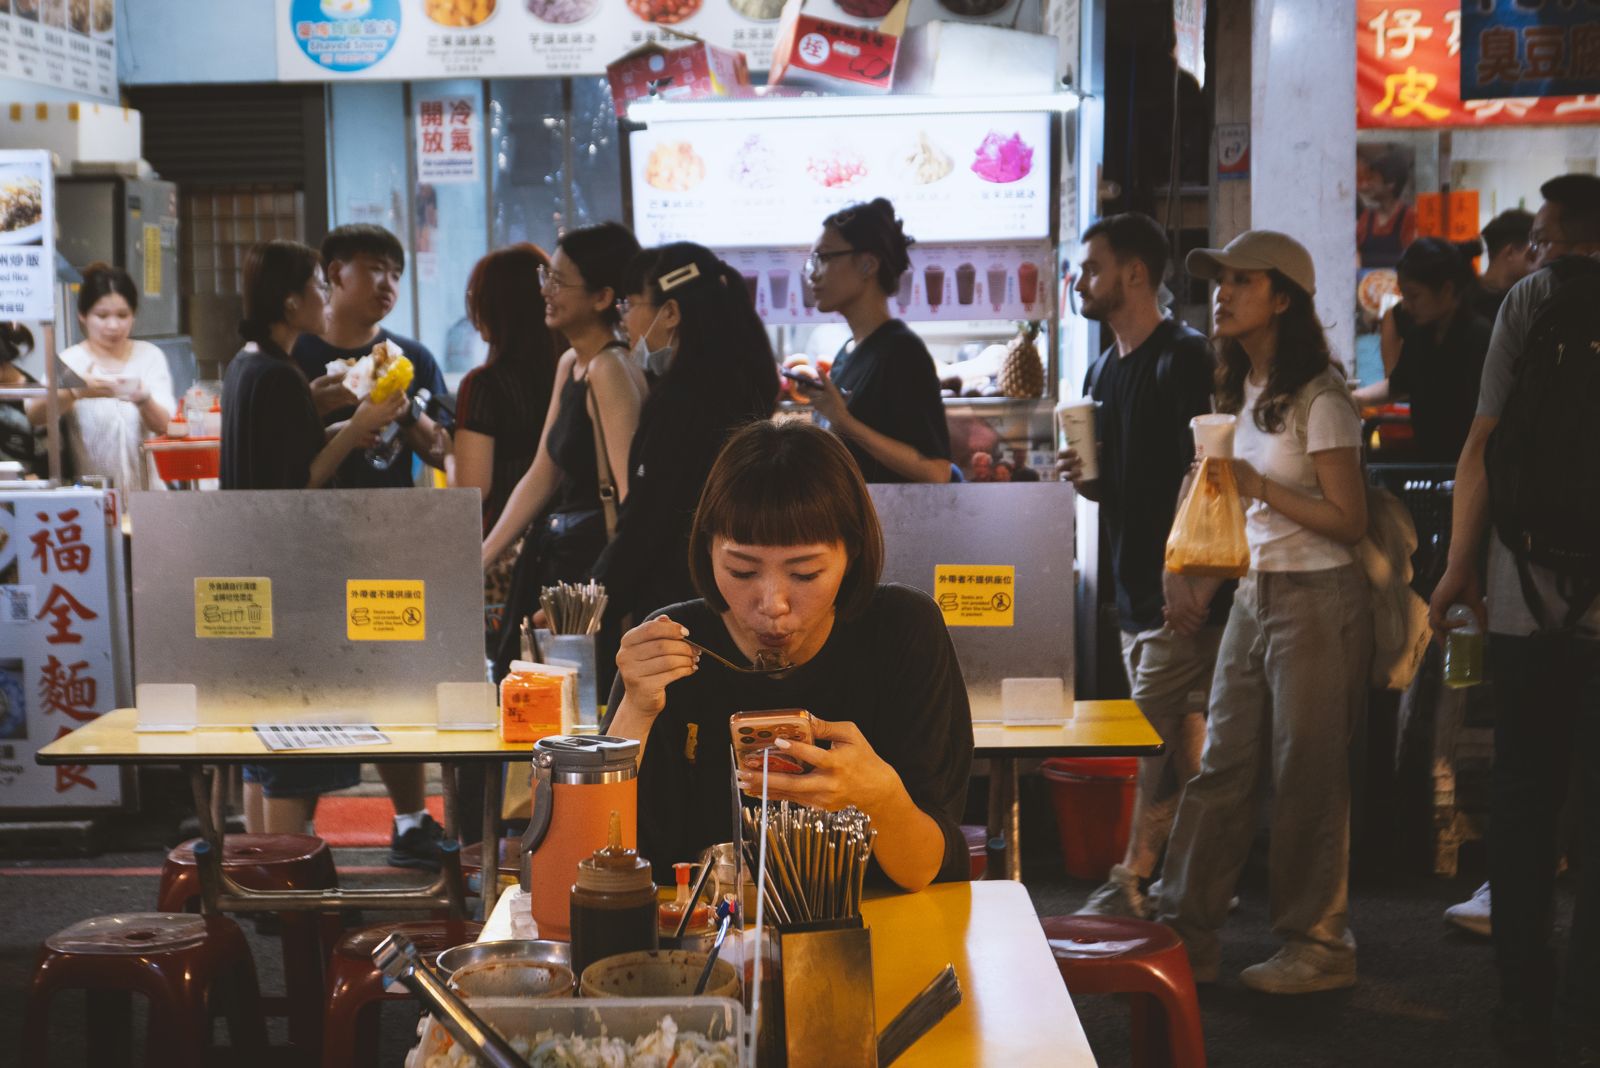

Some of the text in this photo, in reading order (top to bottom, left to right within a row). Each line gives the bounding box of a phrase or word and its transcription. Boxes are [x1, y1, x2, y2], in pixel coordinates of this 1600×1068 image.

[1369, 8, 1460, 59] 仔
[1371, 66, 1451, 120] 皮
[12, 271, 29, 281] Rice
